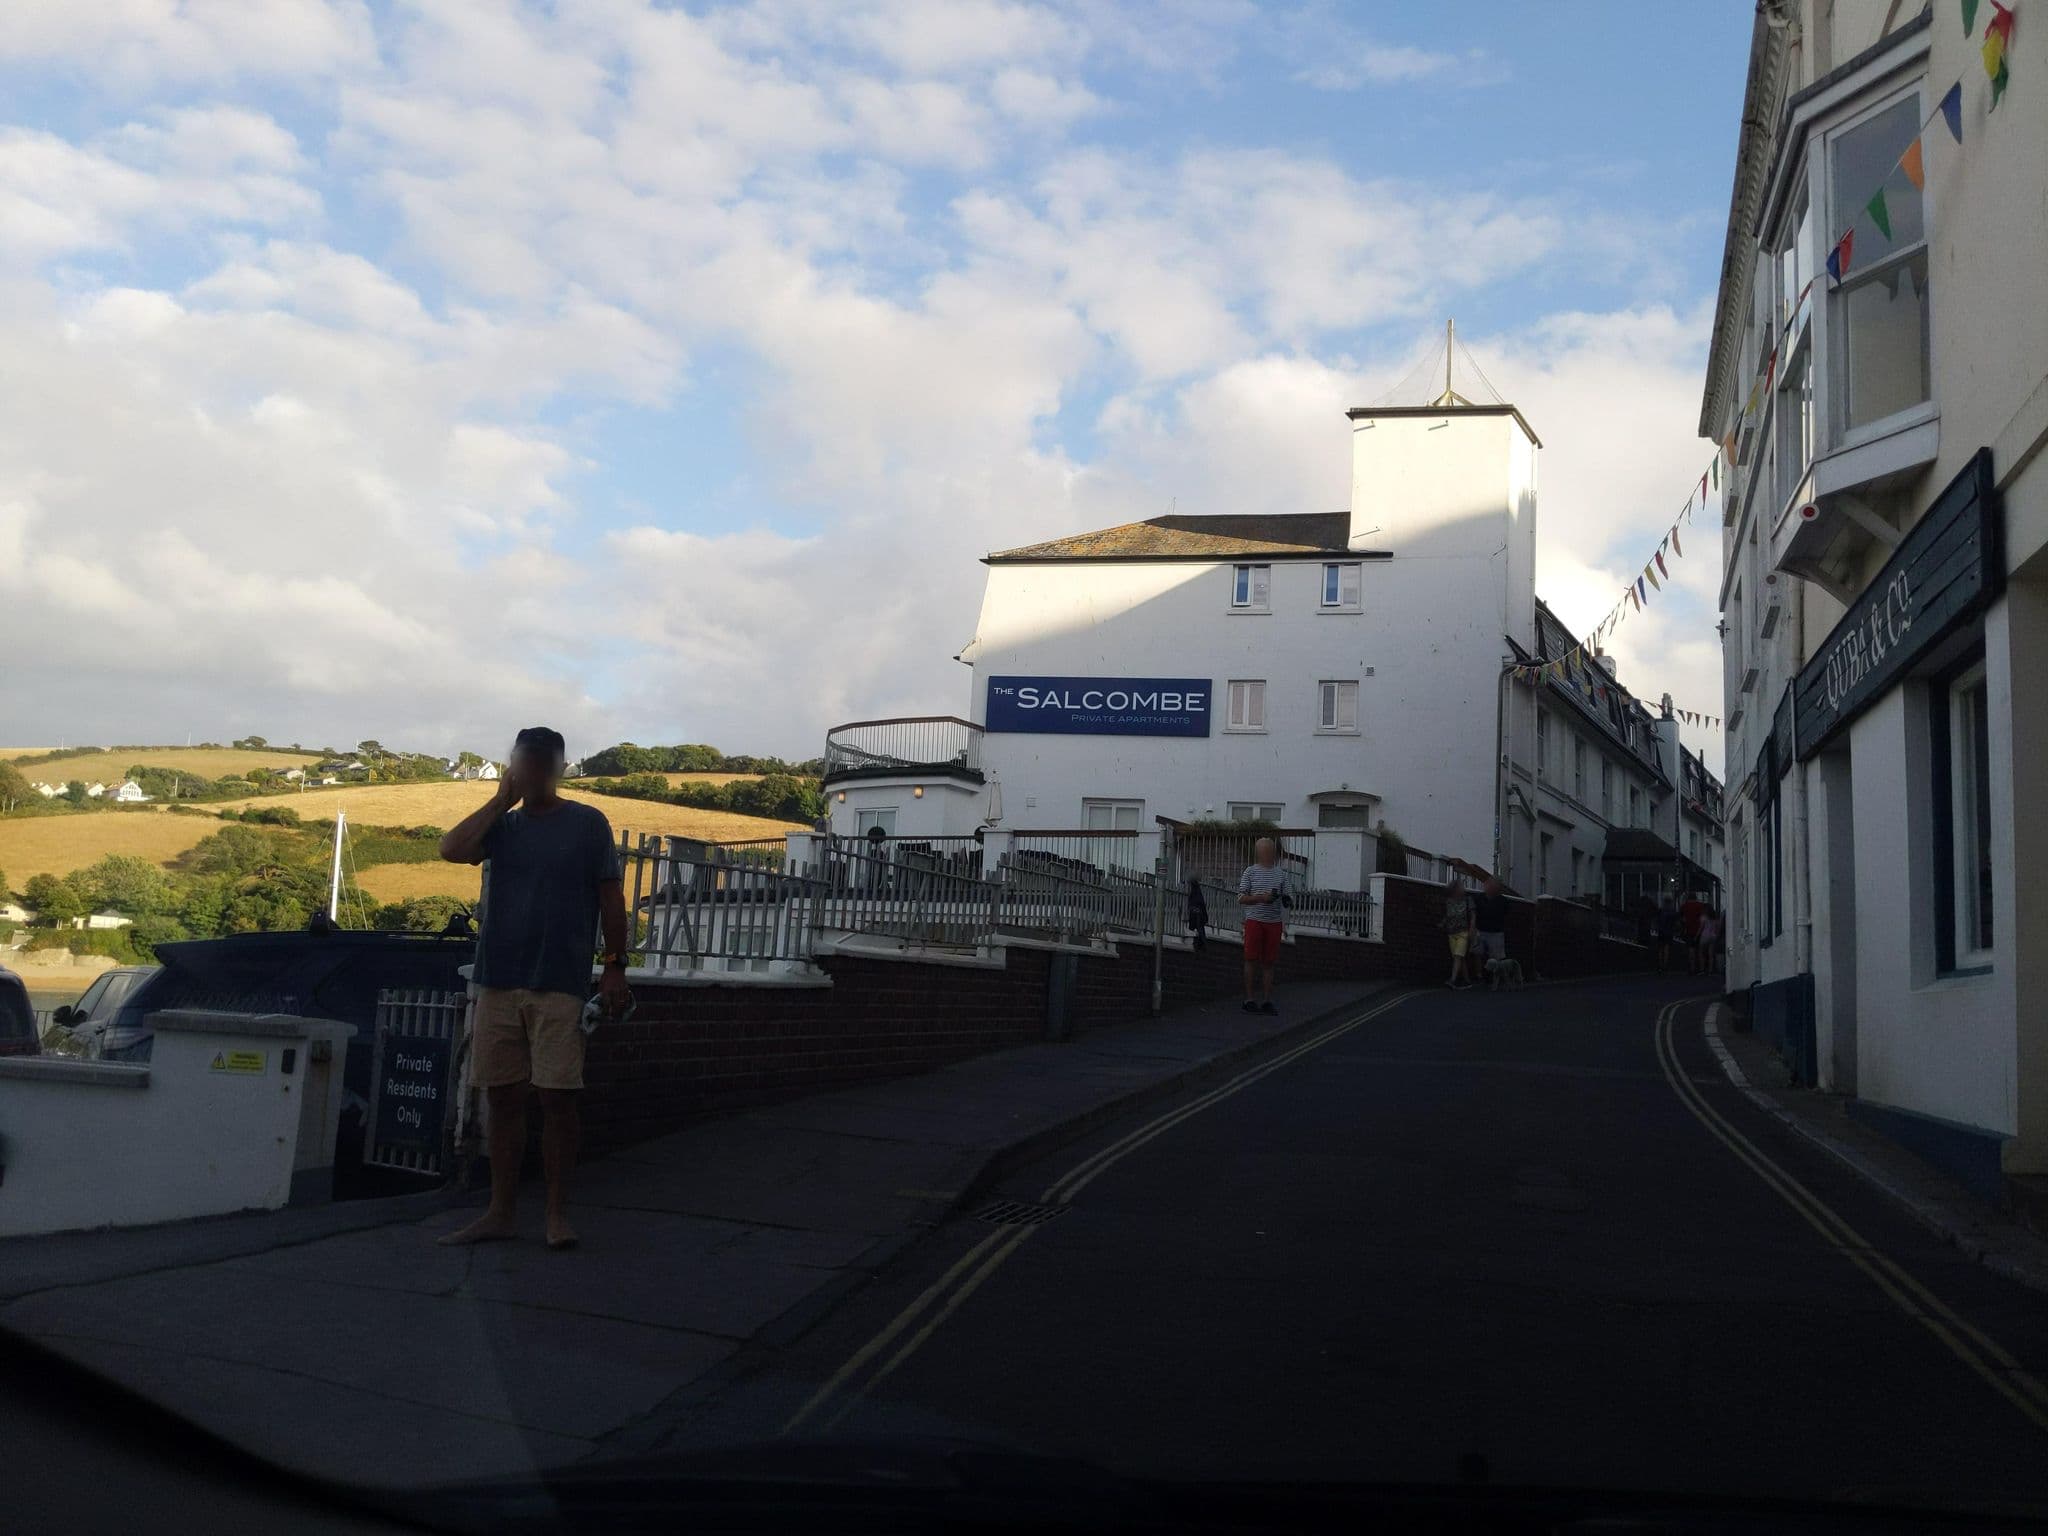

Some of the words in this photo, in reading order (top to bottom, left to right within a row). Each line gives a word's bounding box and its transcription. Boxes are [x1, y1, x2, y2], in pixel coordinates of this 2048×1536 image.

[1871, 602, 1886, 666] &
[994, 687, 1014, 695] THE
[1017, 687, 1205, 711] SALCOMBE
[1071, 714, 1116, 723] PRIVATE
[1118, 716, 1190, 724] APARTMENTS
[396, 1052, 433, 1073] Private
[387, 1080, 437, 1100] Residents
[397, 1105, 421, 1128] Only
